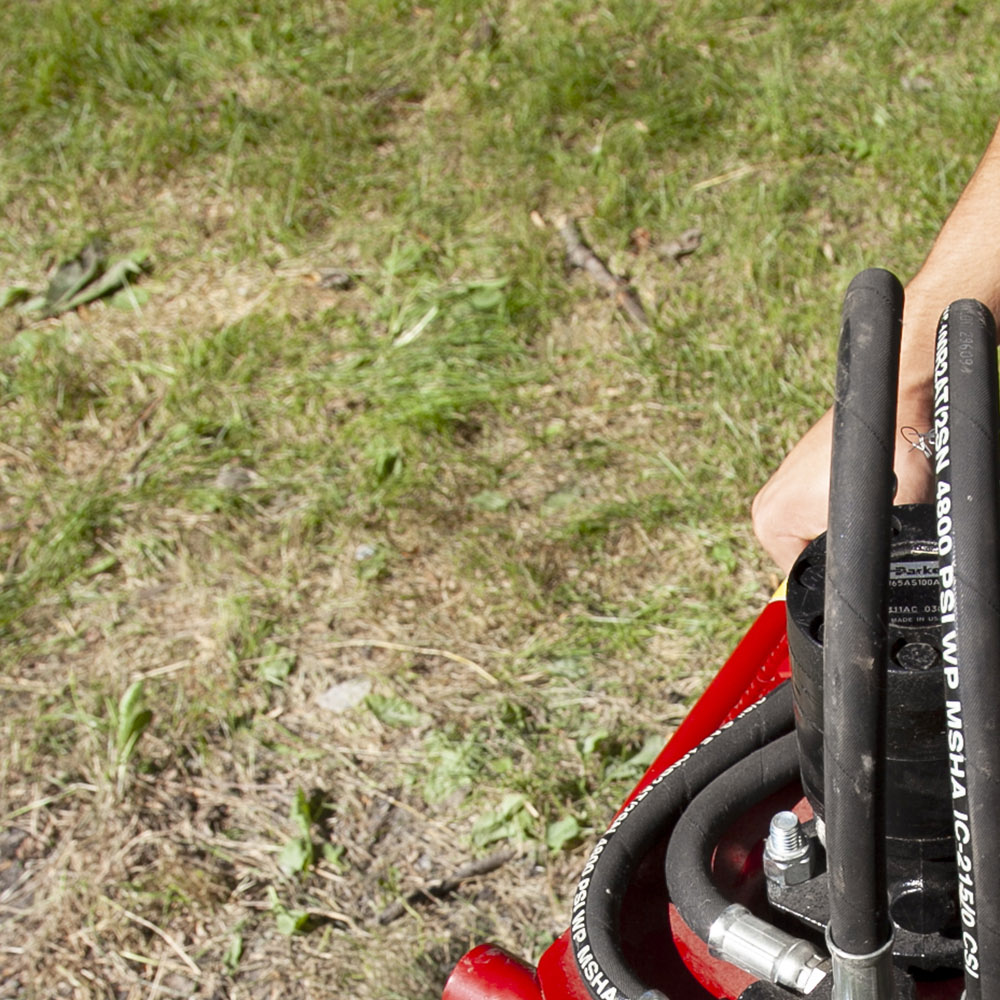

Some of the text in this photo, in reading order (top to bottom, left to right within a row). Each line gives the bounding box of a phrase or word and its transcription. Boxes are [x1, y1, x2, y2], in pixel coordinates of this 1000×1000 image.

[936, 481, 953, 557] 4800
[890, 565, 940, 576] Parke
[938, 565, 956, 624] PSI
[942, 630, 959, 690] WP
[945, 701, 967, 799] MSHA
[573, 878, 590, 912] PSI
[953, 810, 977, 928] IC-215/0
[572, 909, 587, 942] WP
[962, 931, 980, 979] CSI
